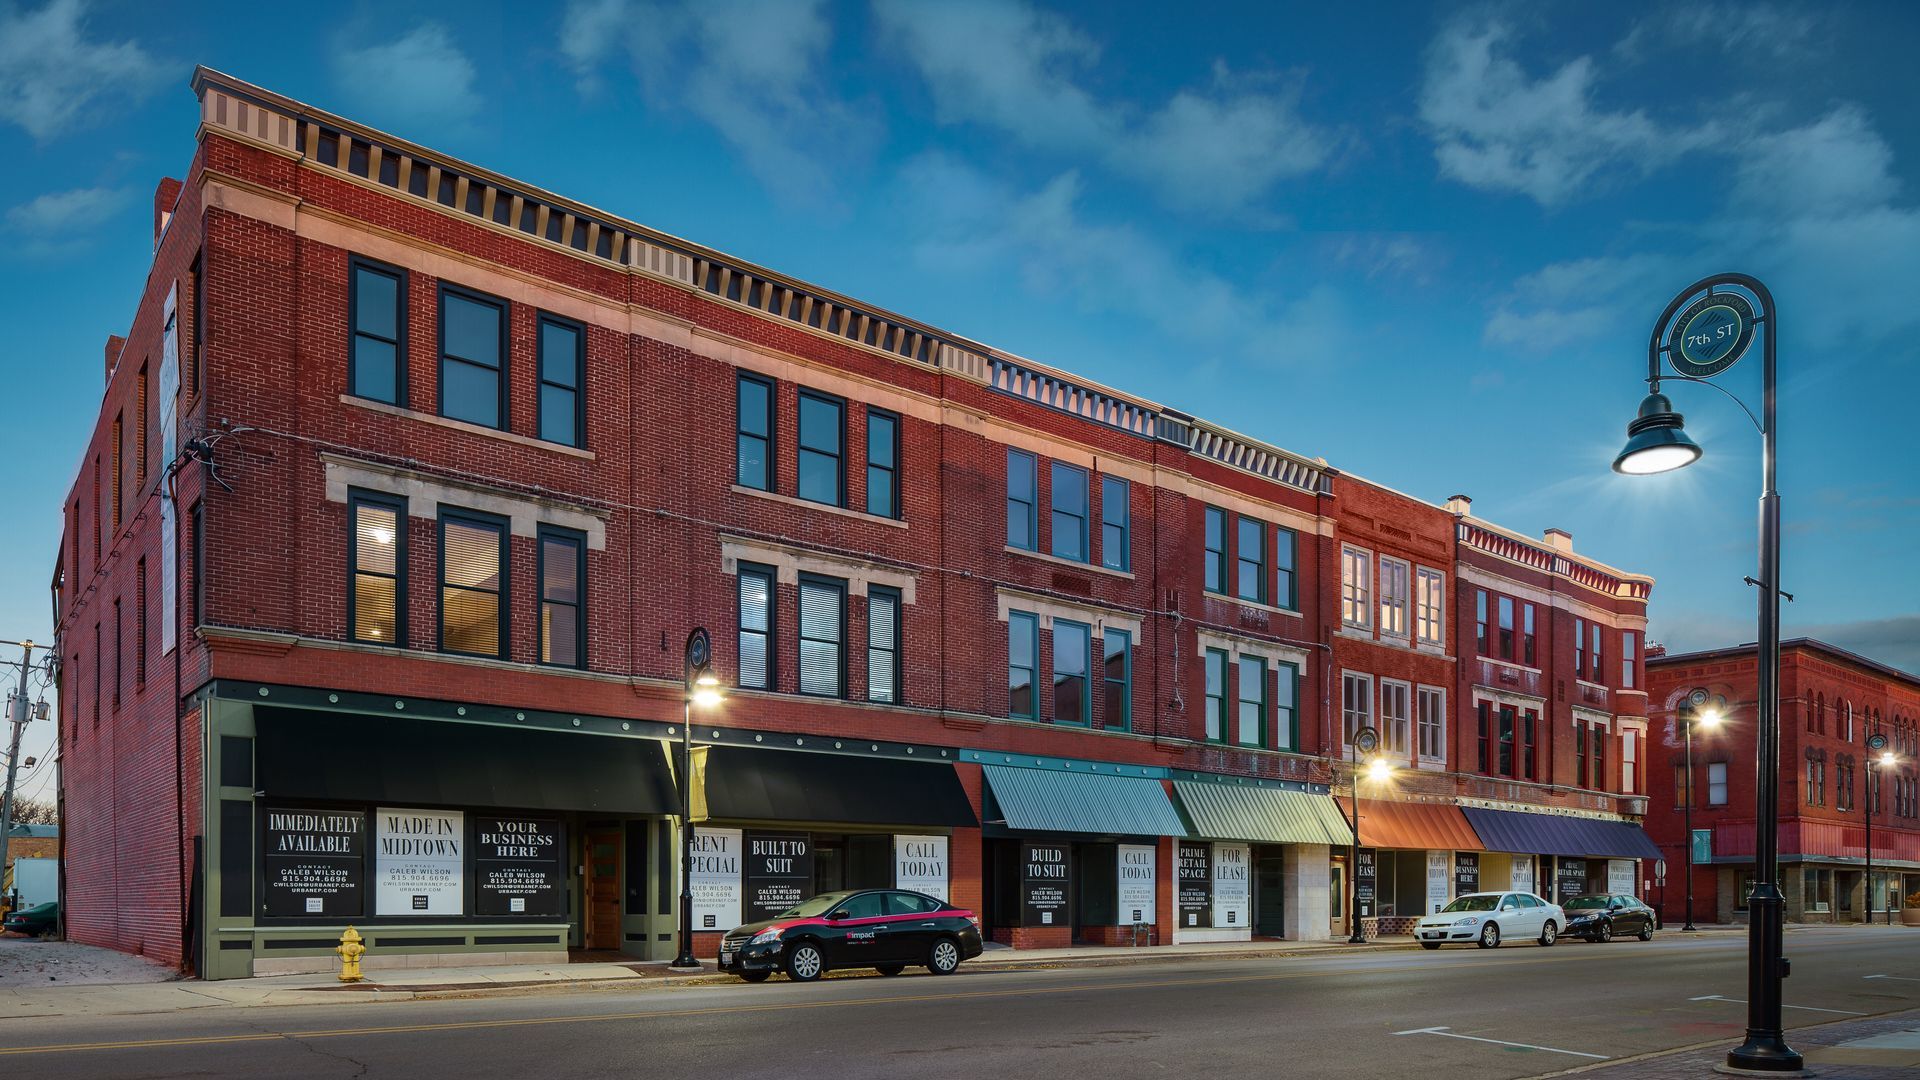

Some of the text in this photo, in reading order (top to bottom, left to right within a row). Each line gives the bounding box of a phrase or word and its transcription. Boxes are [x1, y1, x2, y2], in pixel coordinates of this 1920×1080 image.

[1693, 303, 1703, 315] OF
[1704, 296, 1747, 313] ROCKFORD
[1687, 323, 1735, 348] 7th ST
[270, 814, 359, 833] IMMEDIATELY
[387, 816, 453, 835] MADE IN
[496, 822, 538, 833] YOUR
[278, 835, 350, 852] AVAILABLE
[481, 833, 553, 846] BUSINESS
[692, 836, 728, 852] RENT
[382, 838, 458, 856] MIDTOWN
[497, 846, 538, 857] HERE
[752, 840, 806, 856] BUILT TO
[905, 842, 938, 858] CALL
[1180, 848, 1206, 858] PRIME
[1031, 848, 1062, 862] BUILD
[1125, 852, 1149, 865] CALL
[1222, 849, 1241, 863] FOR
[1359, 853, 1372, 865] FOR
[766, 858, 793, 873] SUIT
[900, 861, 943, 876] TODAY
[1027, 863, 1066, 877] TO SUIT
[1179, 858, 1208, 868] RETAIL
[1456, 865, 1478, 874] BUSINESS
[1121, 866, 1153, 879] TODAY
[1179, 868, 1206, 878] SPACE
[1217, 866, 1247, 880] LEASE
[1359, 865, 1375, 877] EASE
[851, 931, 875, 940] impact
